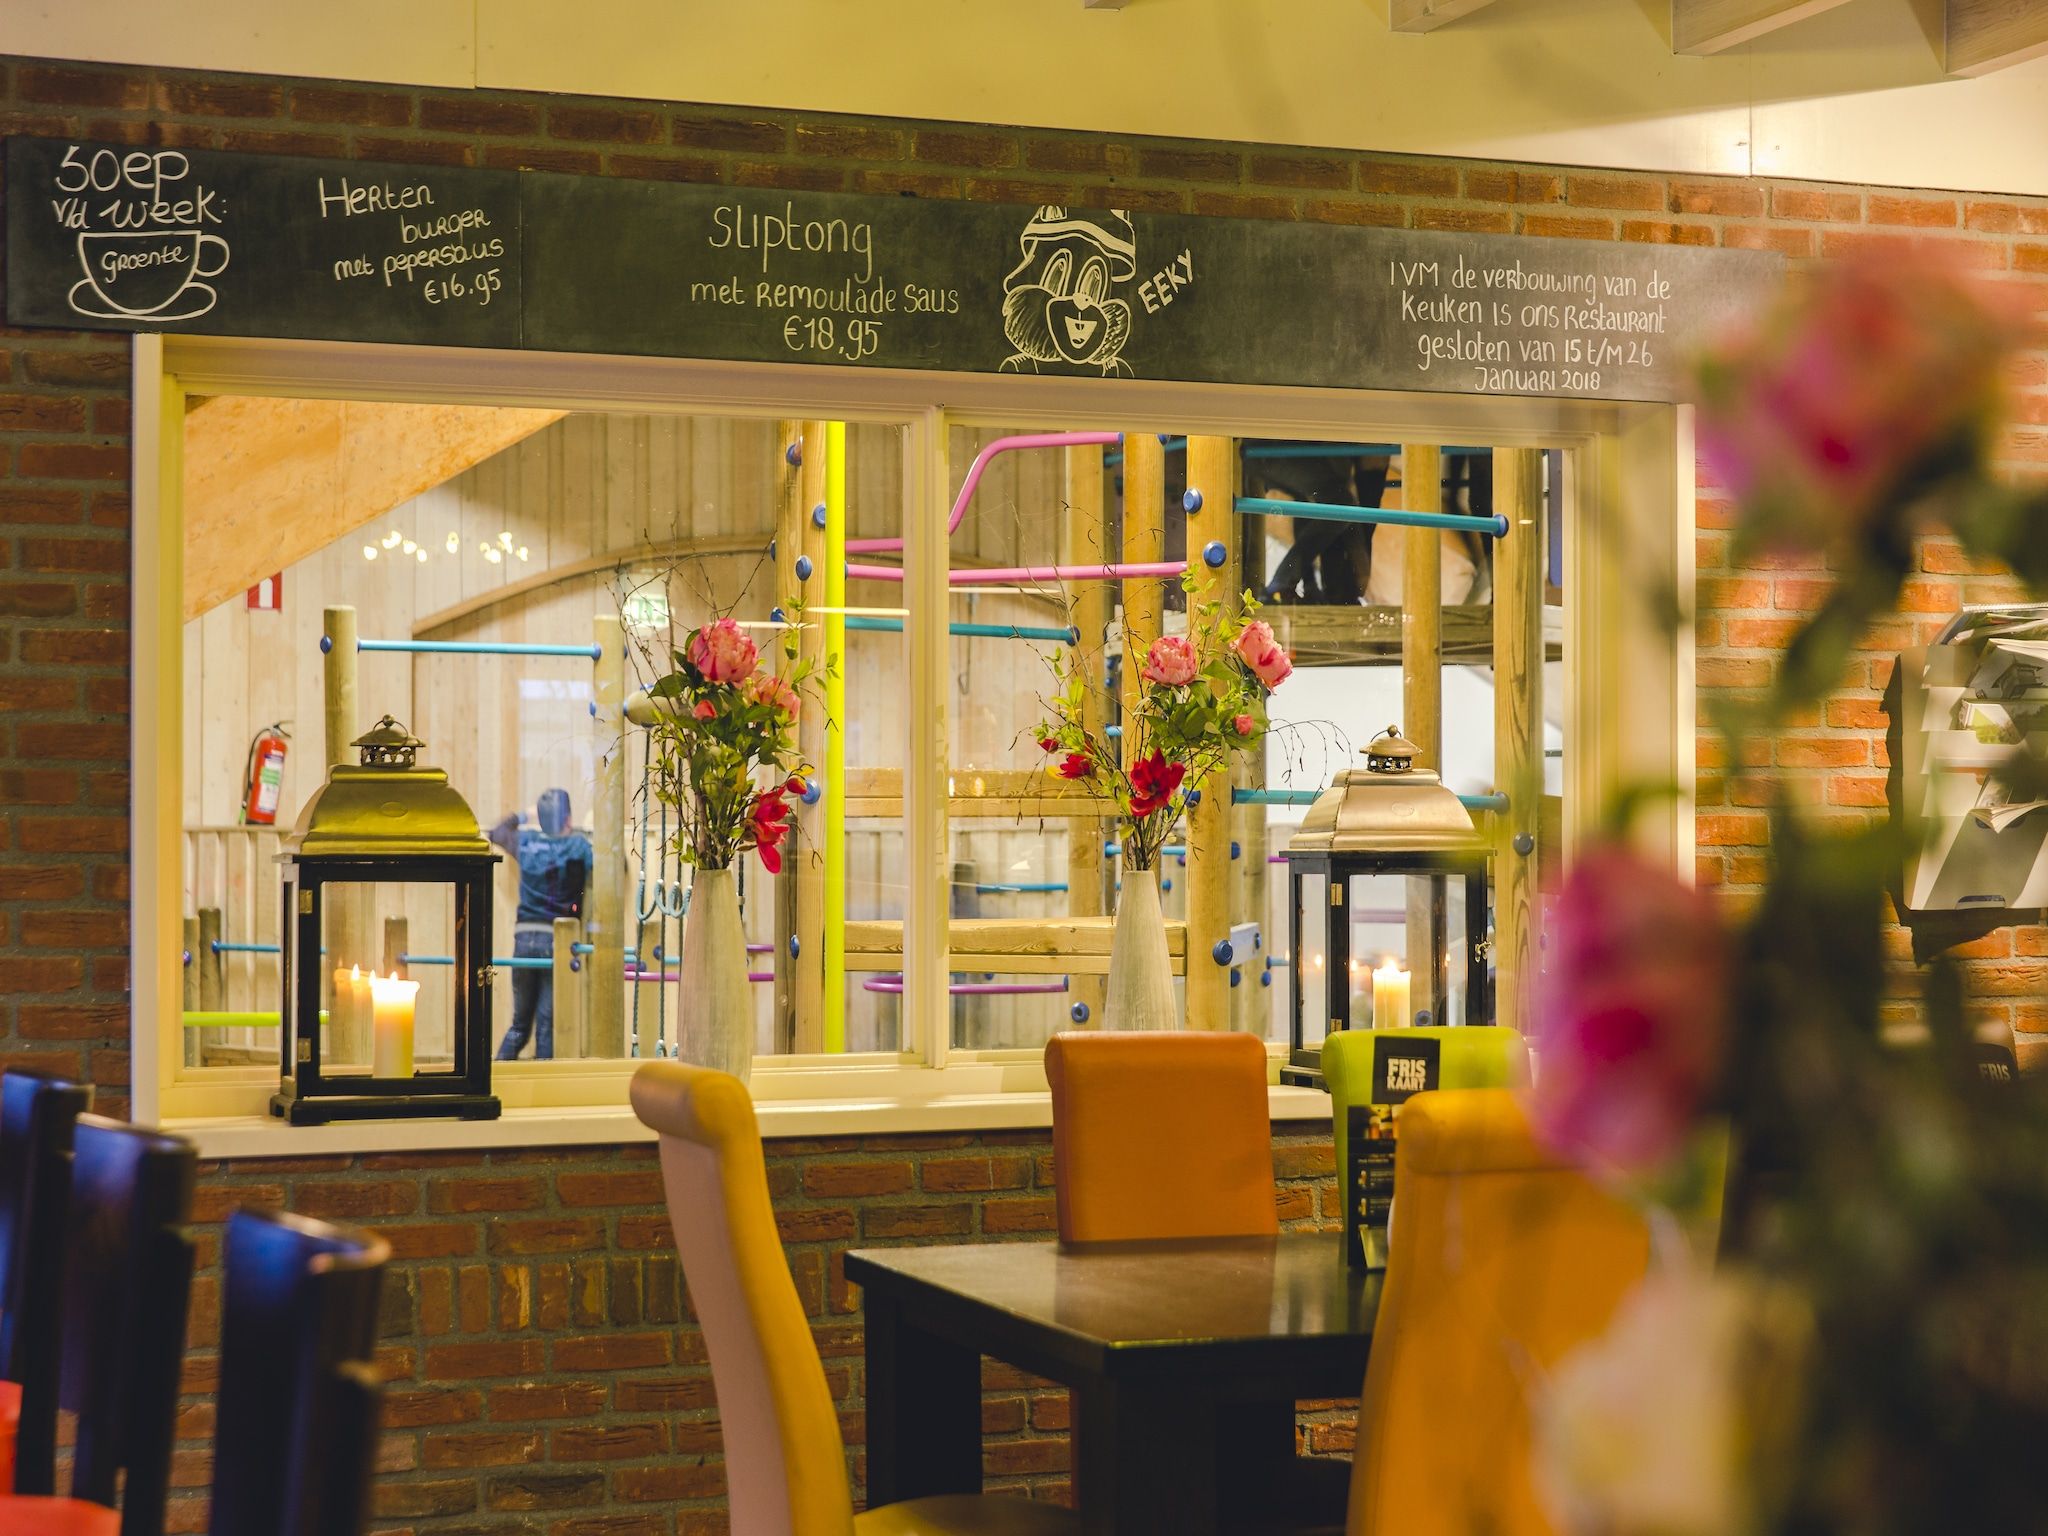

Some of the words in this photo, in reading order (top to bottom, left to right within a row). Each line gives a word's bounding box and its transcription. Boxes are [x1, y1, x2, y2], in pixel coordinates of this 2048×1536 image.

[708, 200, 873, 285] Sliptong
[334, 253, 375, 281] met
[383, 238, 505, 287] pepersaus
[1137, 248, 1193, 314] EEKY
[1451, 253, 1478, 289] de
[1482, 259, 1596, 306] verbouwing
[1603, 275, 1637, 297] van
[1646, 269, 1672, 300] de
[691, 275, 745, 305] met
[1520, 304, 1560, 328] ons
[1564, 302, 1668, 334] Restaurant
[1417, 328, 1510, 371] gesloten
[1518, 339, 1556, 363] van
[1564, 338, 1582, 363] 15
[1626, 339, 1654, 367] 26
[1560, 369, 1601, 391] 2018
[1386, 1075, 1426, 1090] KAART
[1387, 1058, 1427, 1078] FRIS
